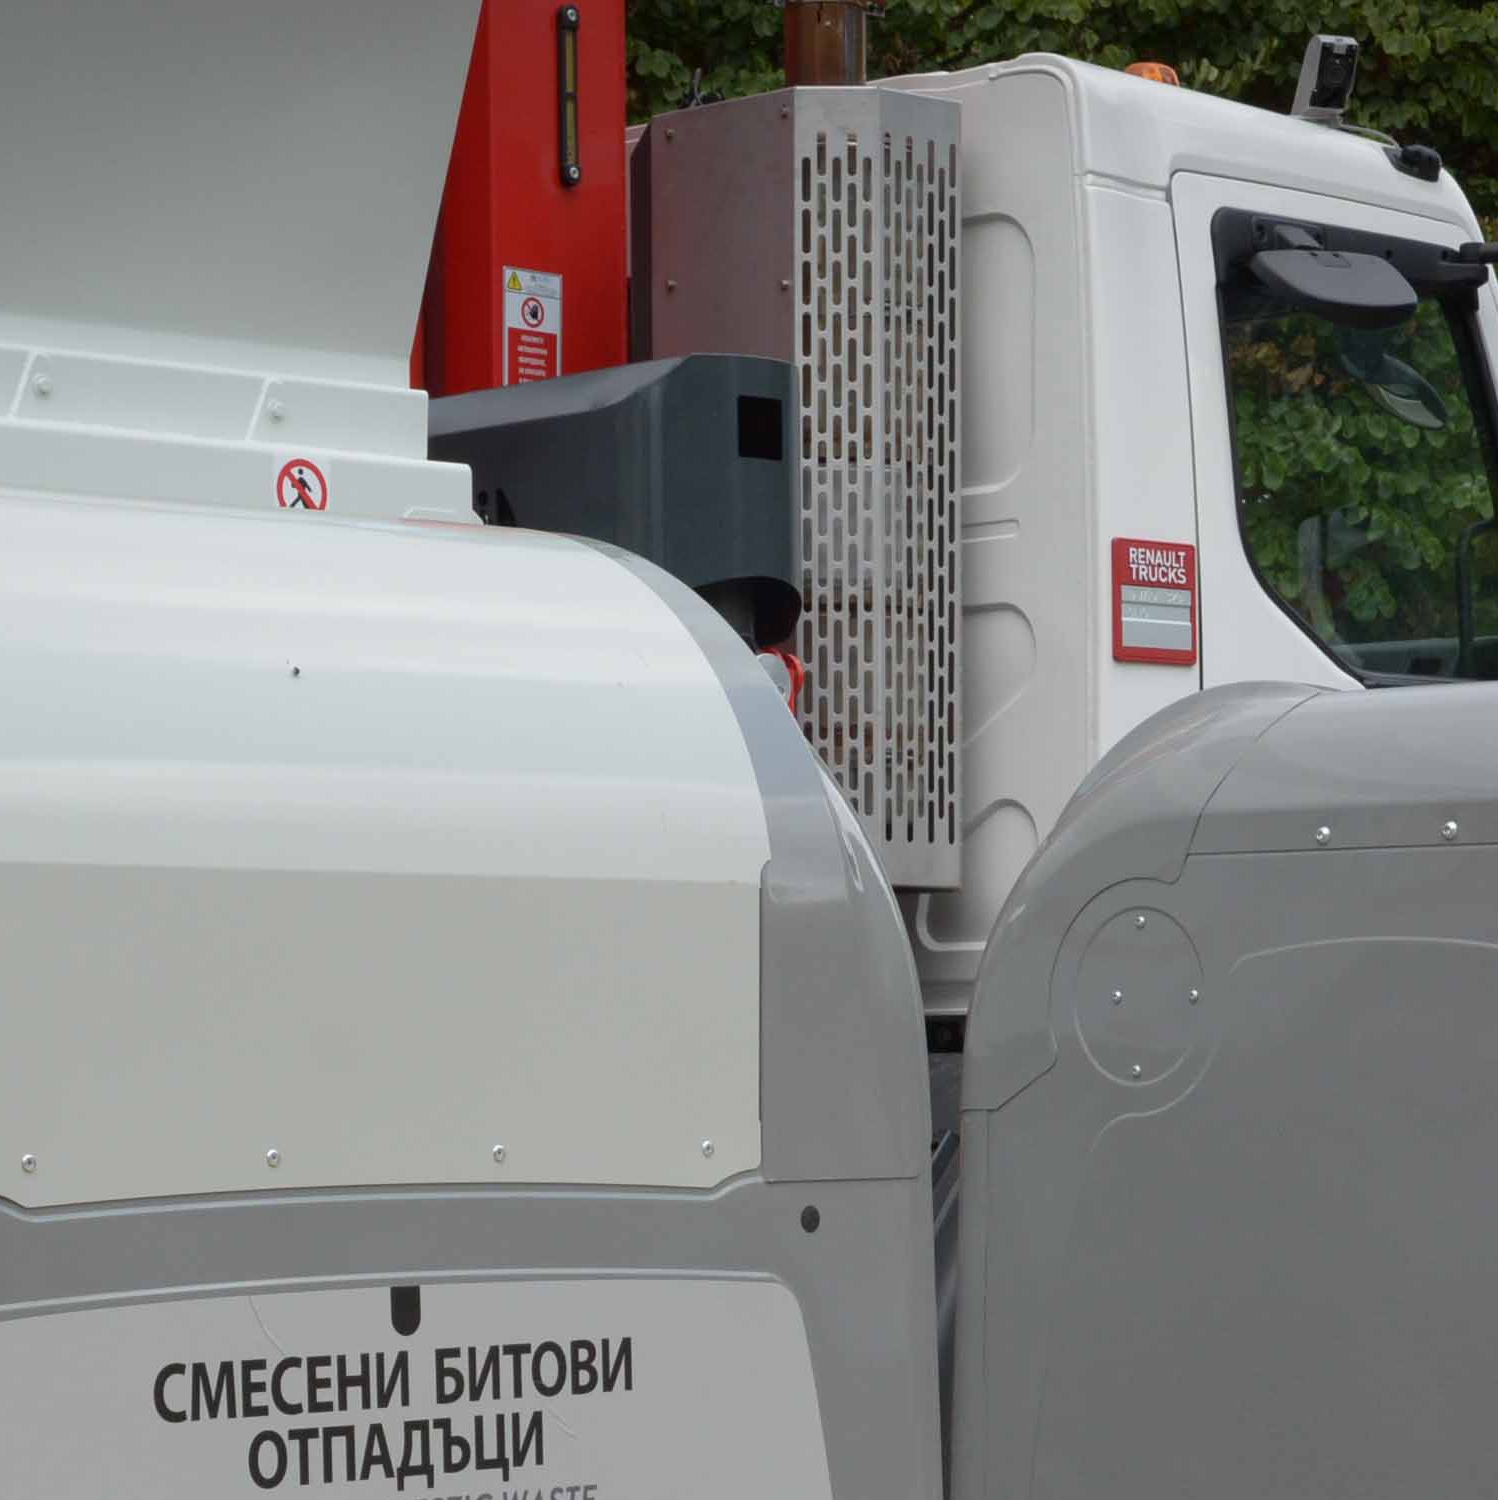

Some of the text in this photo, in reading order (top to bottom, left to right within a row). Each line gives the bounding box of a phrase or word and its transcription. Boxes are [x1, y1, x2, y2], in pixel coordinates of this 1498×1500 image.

[1129, 547, 1186, 568] RENAULT
[1130, 564, 1187, 584] TRUCKS
[154, 1337, 632, 1423] СМЕСЕНИ БИТОВИ
[249, 1411, 543, 1491] ОТПАДЪЦИ
